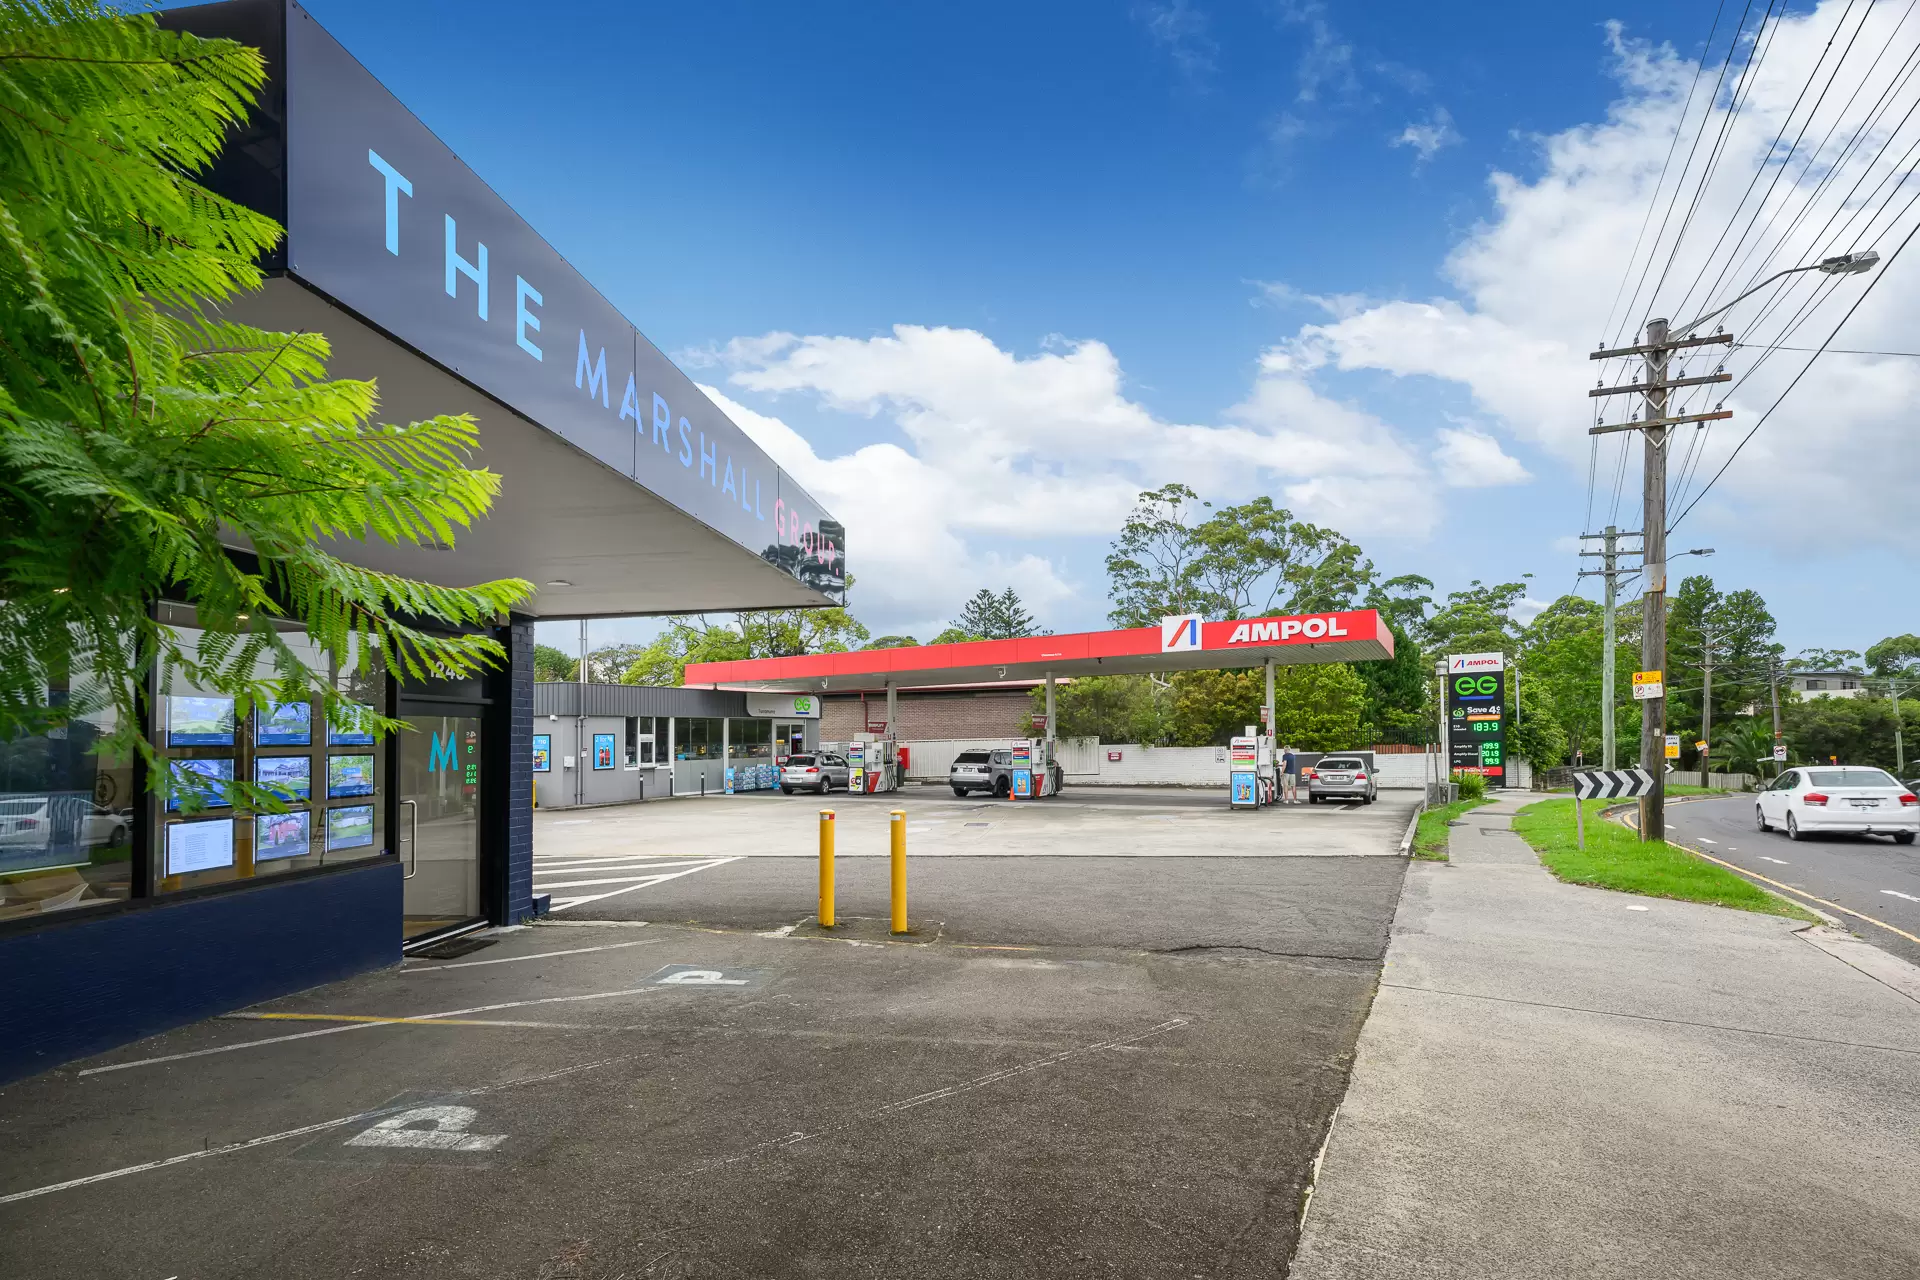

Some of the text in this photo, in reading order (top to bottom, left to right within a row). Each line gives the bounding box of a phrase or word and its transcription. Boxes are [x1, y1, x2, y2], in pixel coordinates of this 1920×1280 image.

[368, 148, 544, 363] THE
[574, 328, 765, 522] MARSHALL
[1227, 617, 1348, 644] AMPOL
[1466, 659, 1499, 667] AMPOL
[1467, 706, 1488, 714] Save
[1473, 722, 1499, 732] 183.9
[428, 731, 459, 772] M
